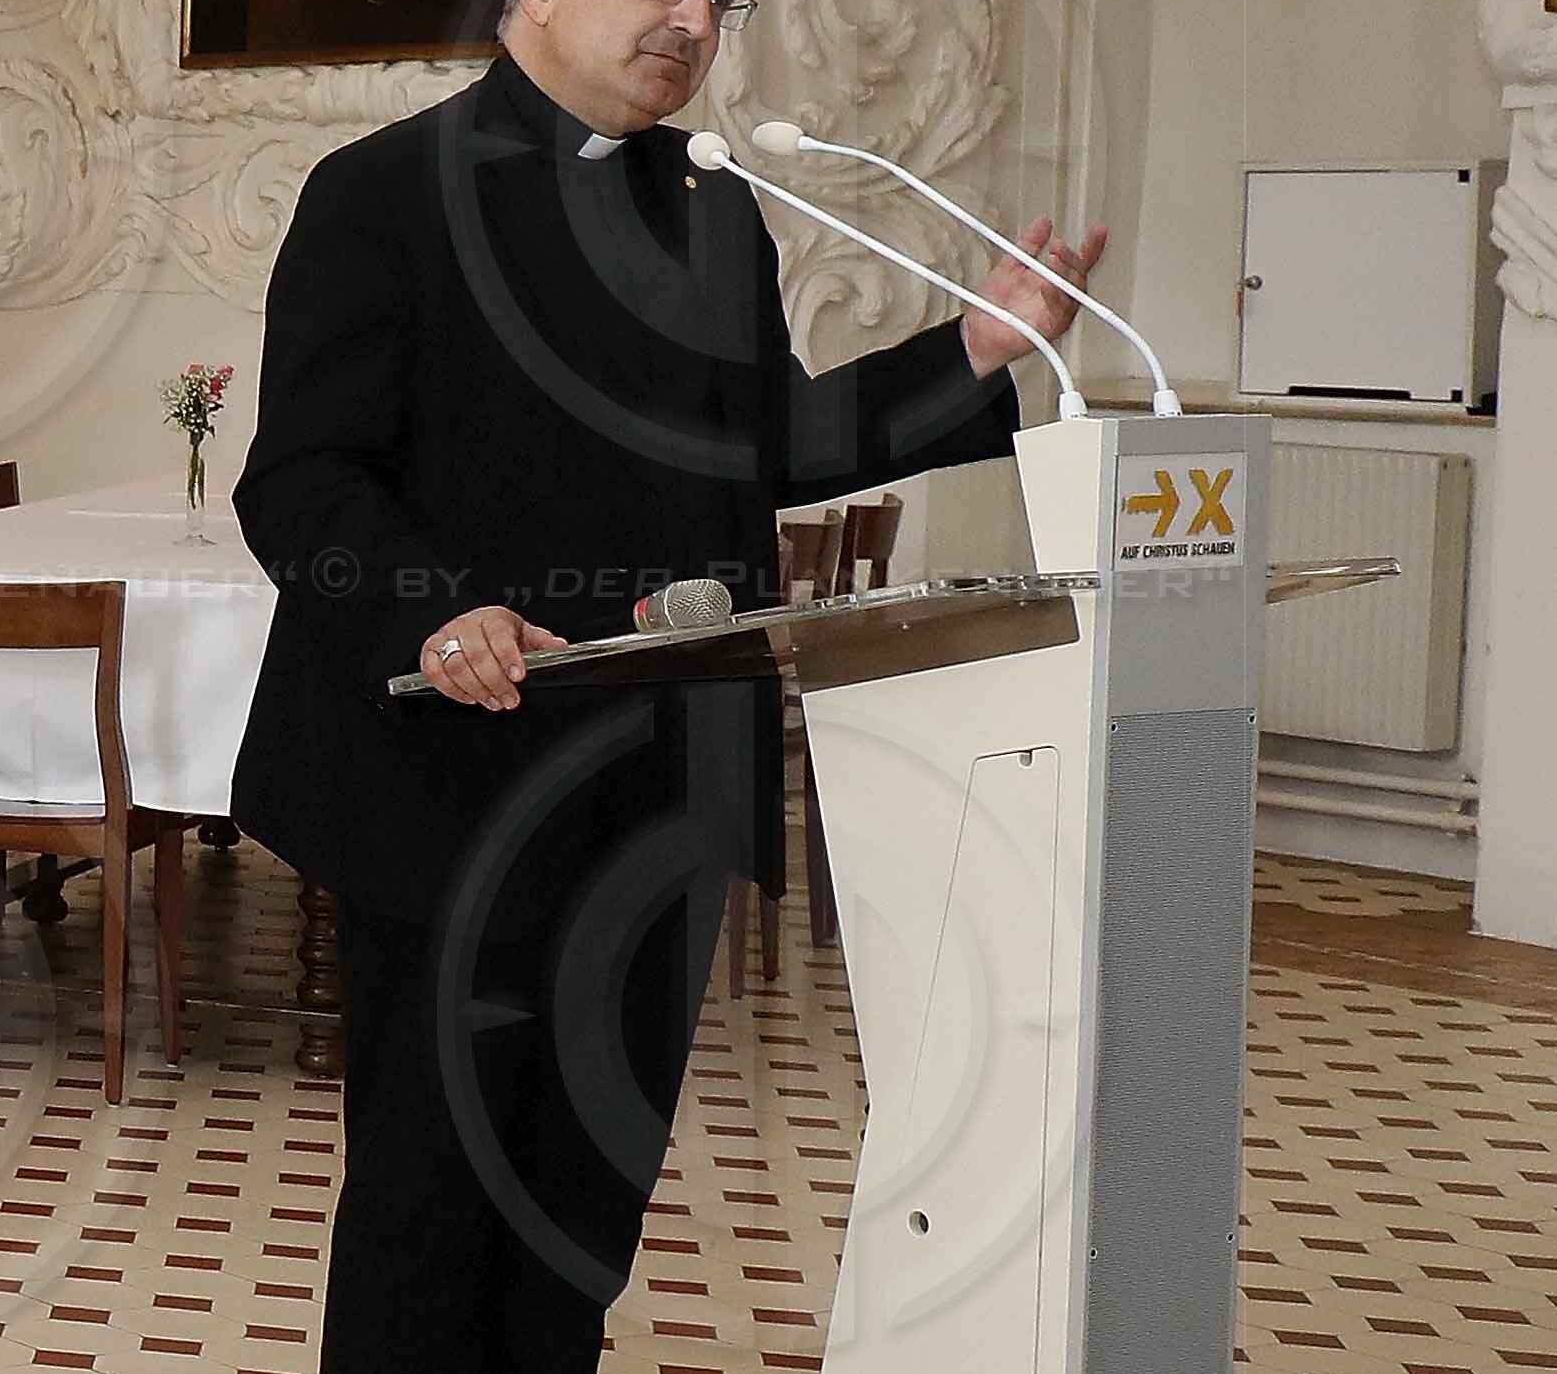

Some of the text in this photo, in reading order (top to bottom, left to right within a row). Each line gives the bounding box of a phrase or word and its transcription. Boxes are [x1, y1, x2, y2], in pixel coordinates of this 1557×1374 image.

[1121, 540, 1235, 559] AUF CHRISTUS SCHAUEN
